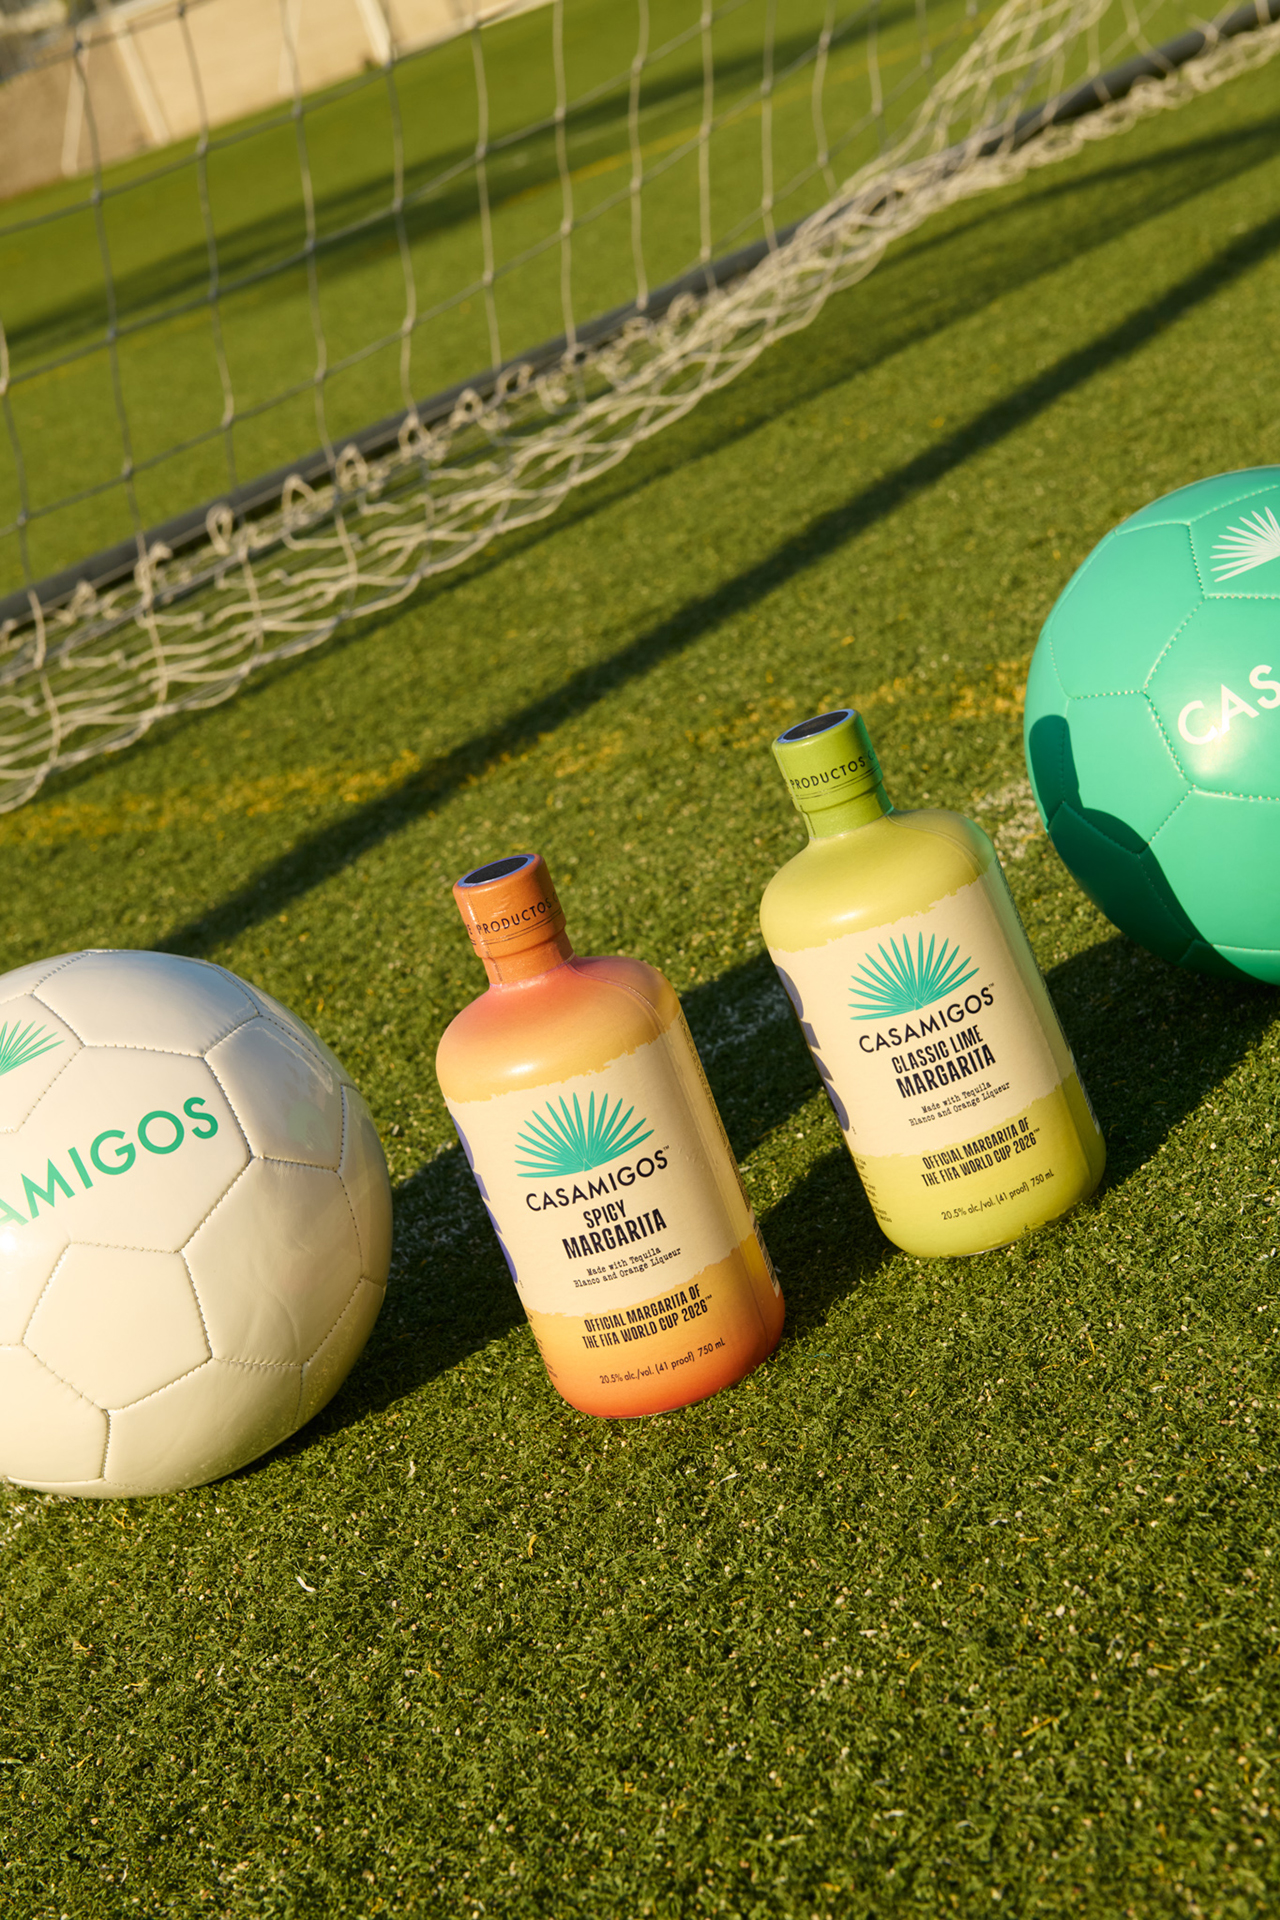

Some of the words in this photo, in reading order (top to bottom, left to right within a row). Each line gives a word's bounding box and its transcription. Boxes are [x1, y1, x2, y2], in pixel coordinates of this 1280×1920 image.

[790, 756, 866, 789] PRODUCTOS
[476, 897, 552, 934] PRODUCTOS
[891, 1040, 950, 1074] CLASSIC
[950, 1024, 983, 1054] LIME
[896, 1043, 996, 1099] MARGARITA
[908, 1113, 935, 1126] Blanco
[937, 1107, 952, 1118] and
[953, 1096, 981, 1113] Orange
[981, 1082, 1010, 1101] Liqueur
[921, 1102, 941, 1113] Made
[942, 1094, 961, 1106] with
[962, 1082, 992, 1100] Tequila
[922, 1148, 964, 1170] OFFICIAL
[962, 1124, 1019, 1158] MARGARITA
[1018, 1116, 1030, 1133] OF
[921, 1172, 941, 1187] THE
[939, 1166, 961, 1183] FIFA
[959, 1153, 994, 1177] WORLD
[993, 1144, 1012, 1163] CUP
[583, 1199, 627, 1229] SPICY
[941, 1207, 967, 1220] 20.5%
[995, 1192, 1008, 1205] (41
[1009, 1182, 1030, 1200] proof)
[1030, 1173, 1045, 1187] 750
[1045, 1168, 1055, 1180] mL
[562, 1208, 667, 1259] MARGARITA
[573, 1277, 600, 1288] Blanco
[602, 1271, 618, 1282] and
[619, 1262, 648, 1278] Orange
[650, 1247, 681, 1267] Liqueur
[586, 1266, 606, 1276] Made
[608, 1259, 628, 1270] with
[629, 1247, 661, 1264] Tequila
[584, 1313, 627, 1332] OFFICIAL
[625, 1291, 688, 1324] MARGARITA
[688, 1283, 701, 1300] OF
[582, 1335, 600, 1349] THE
[599, 1332, 621, 1347] FIFA
[620, 1321, 658, 1343] WORLD
[658, 1312, 679, 1331] CUP
[599, 1373, 623, 1384] 20.5%
[624, 1366, 654, 1381] alc./vol.
[655, 1361, 669, 1375] (41
[671, 1351, 695, 1370] proof)
[697, 1343, 714, 1357] 750
[714, 1338, 726, 1350] mL
